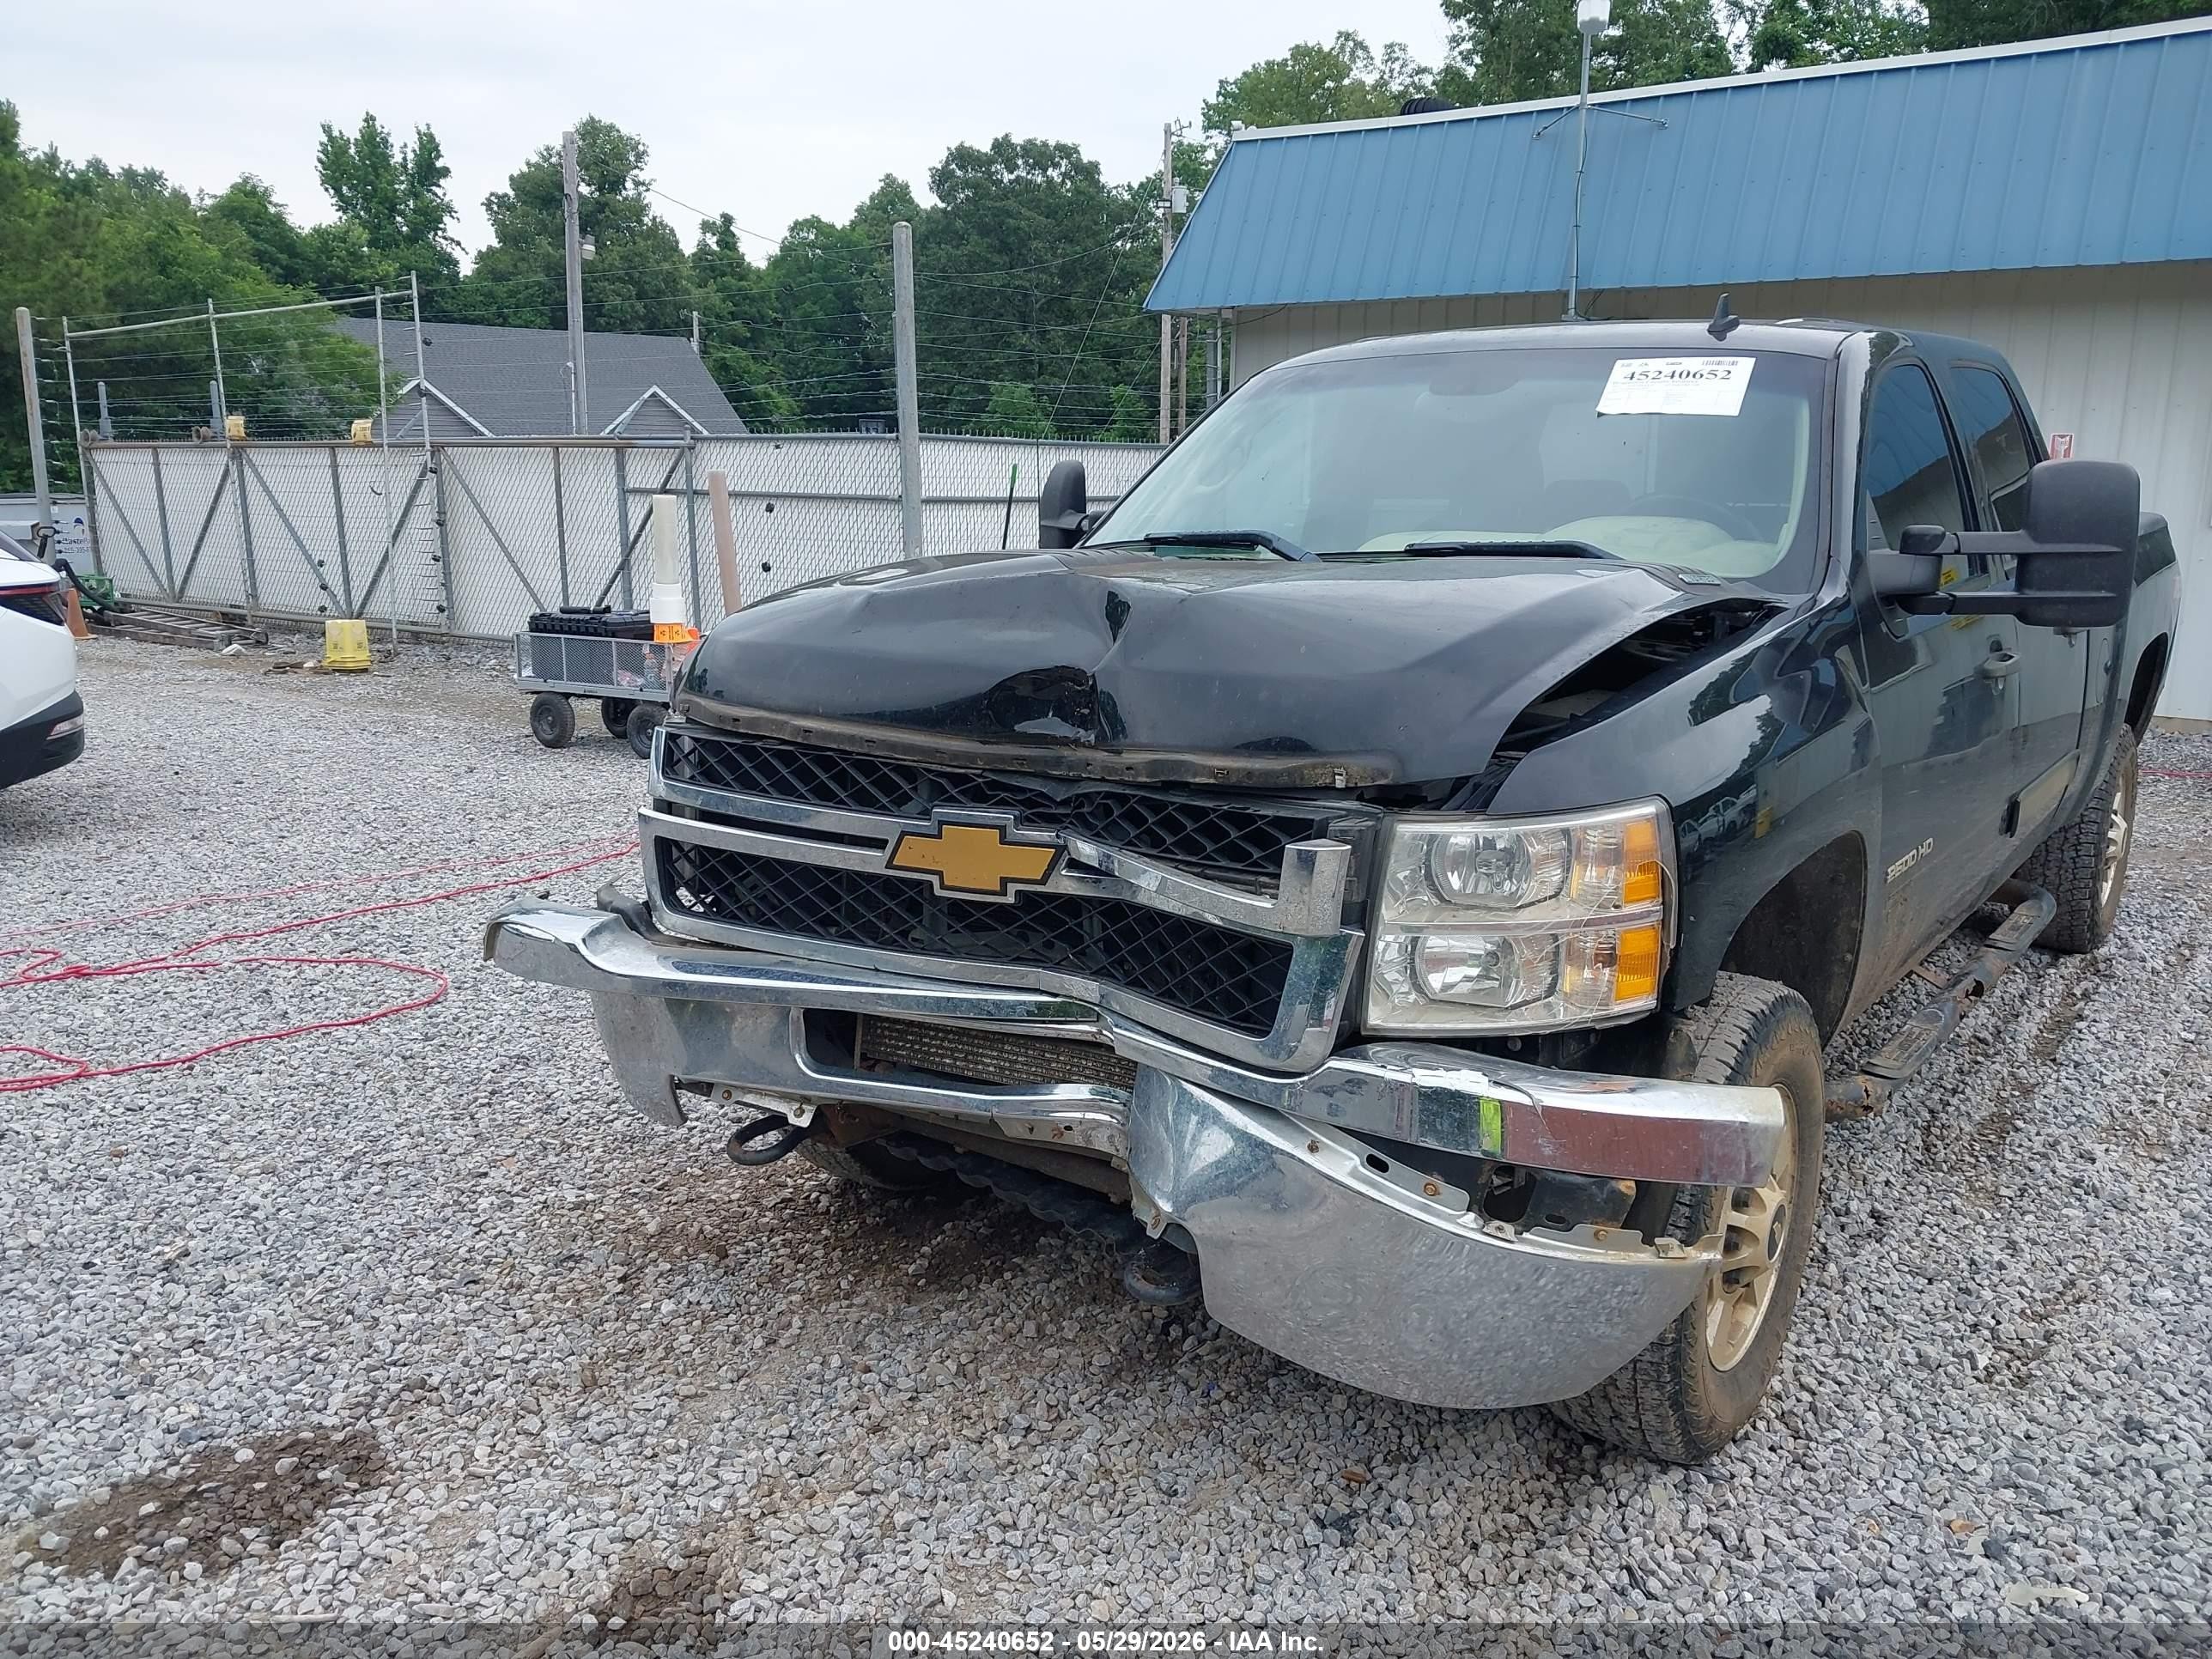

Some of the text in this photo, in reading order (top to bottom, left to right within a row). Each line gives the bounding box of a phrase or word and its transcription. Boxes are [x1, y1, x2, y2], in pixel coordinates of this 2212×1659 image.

[1624, 369, 1732, 381] 45240652
[1887, 837, 1934, 883] 2500 HD
